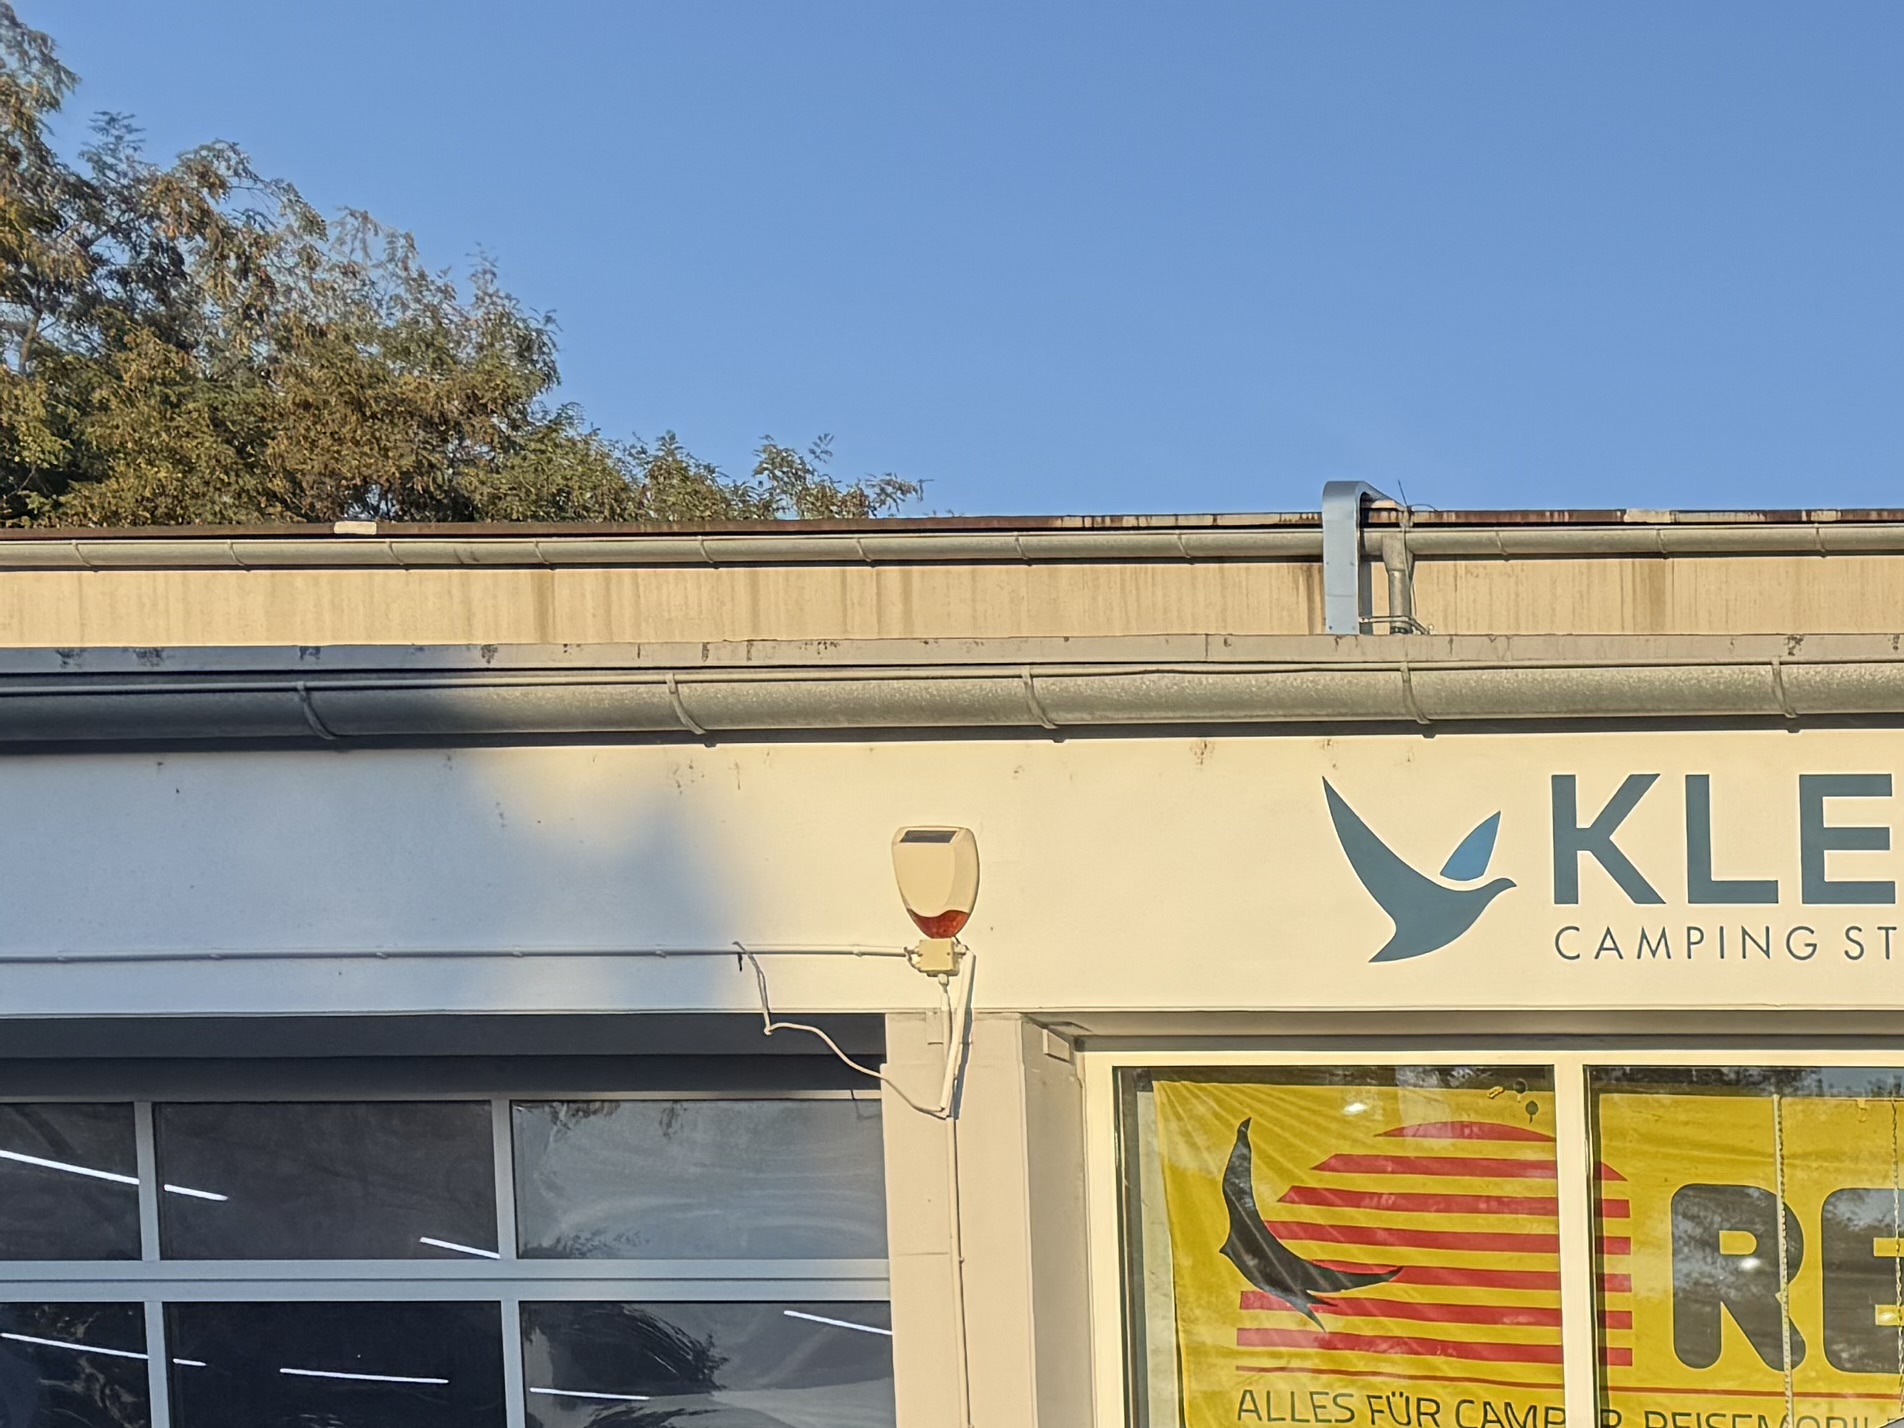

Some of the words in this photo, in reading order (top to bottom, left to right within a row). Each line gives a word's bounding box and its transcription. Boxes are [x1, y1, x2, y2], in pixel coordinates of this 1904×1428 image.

[1554, 925, 1819, 963] CAMPING
[1236, 1388, 1356, 1424] ALLES
[1366, 1391, 1441, 1428] FÜR
